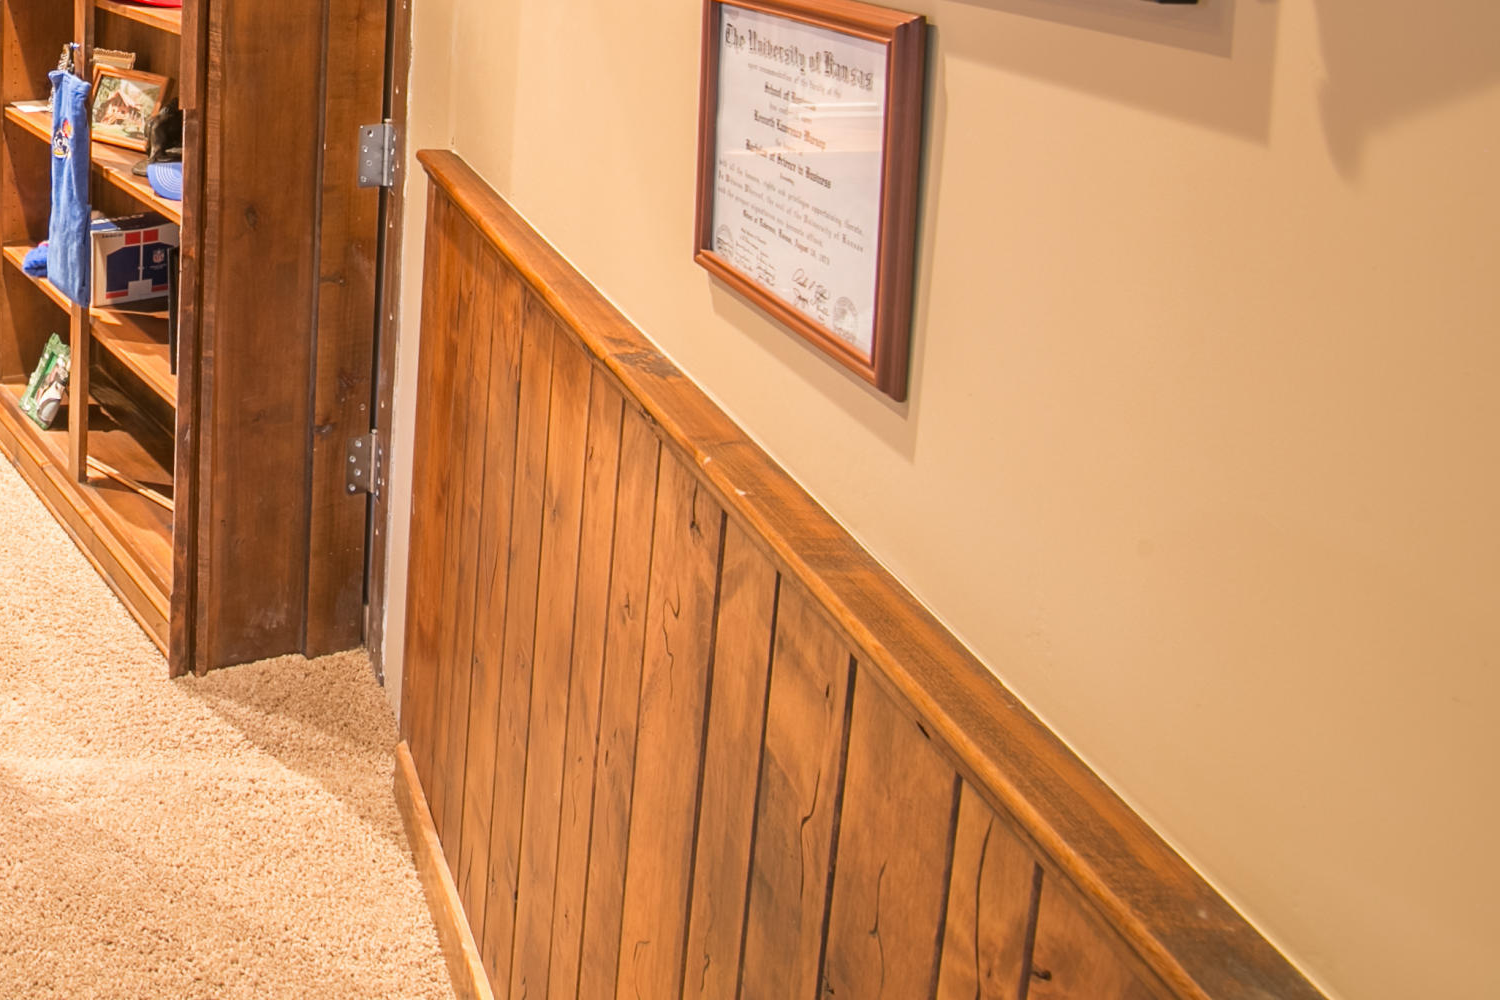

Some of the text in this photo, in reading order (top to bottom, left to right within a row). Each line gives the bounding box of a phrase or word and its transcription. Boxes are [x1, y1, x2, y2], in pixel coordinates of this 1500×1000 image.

[725, 22, 747, 48] The
[748, 28, 807, 76] University
[808, 51, 823, 75] of
[824, 50, 875, 92] Kansas
